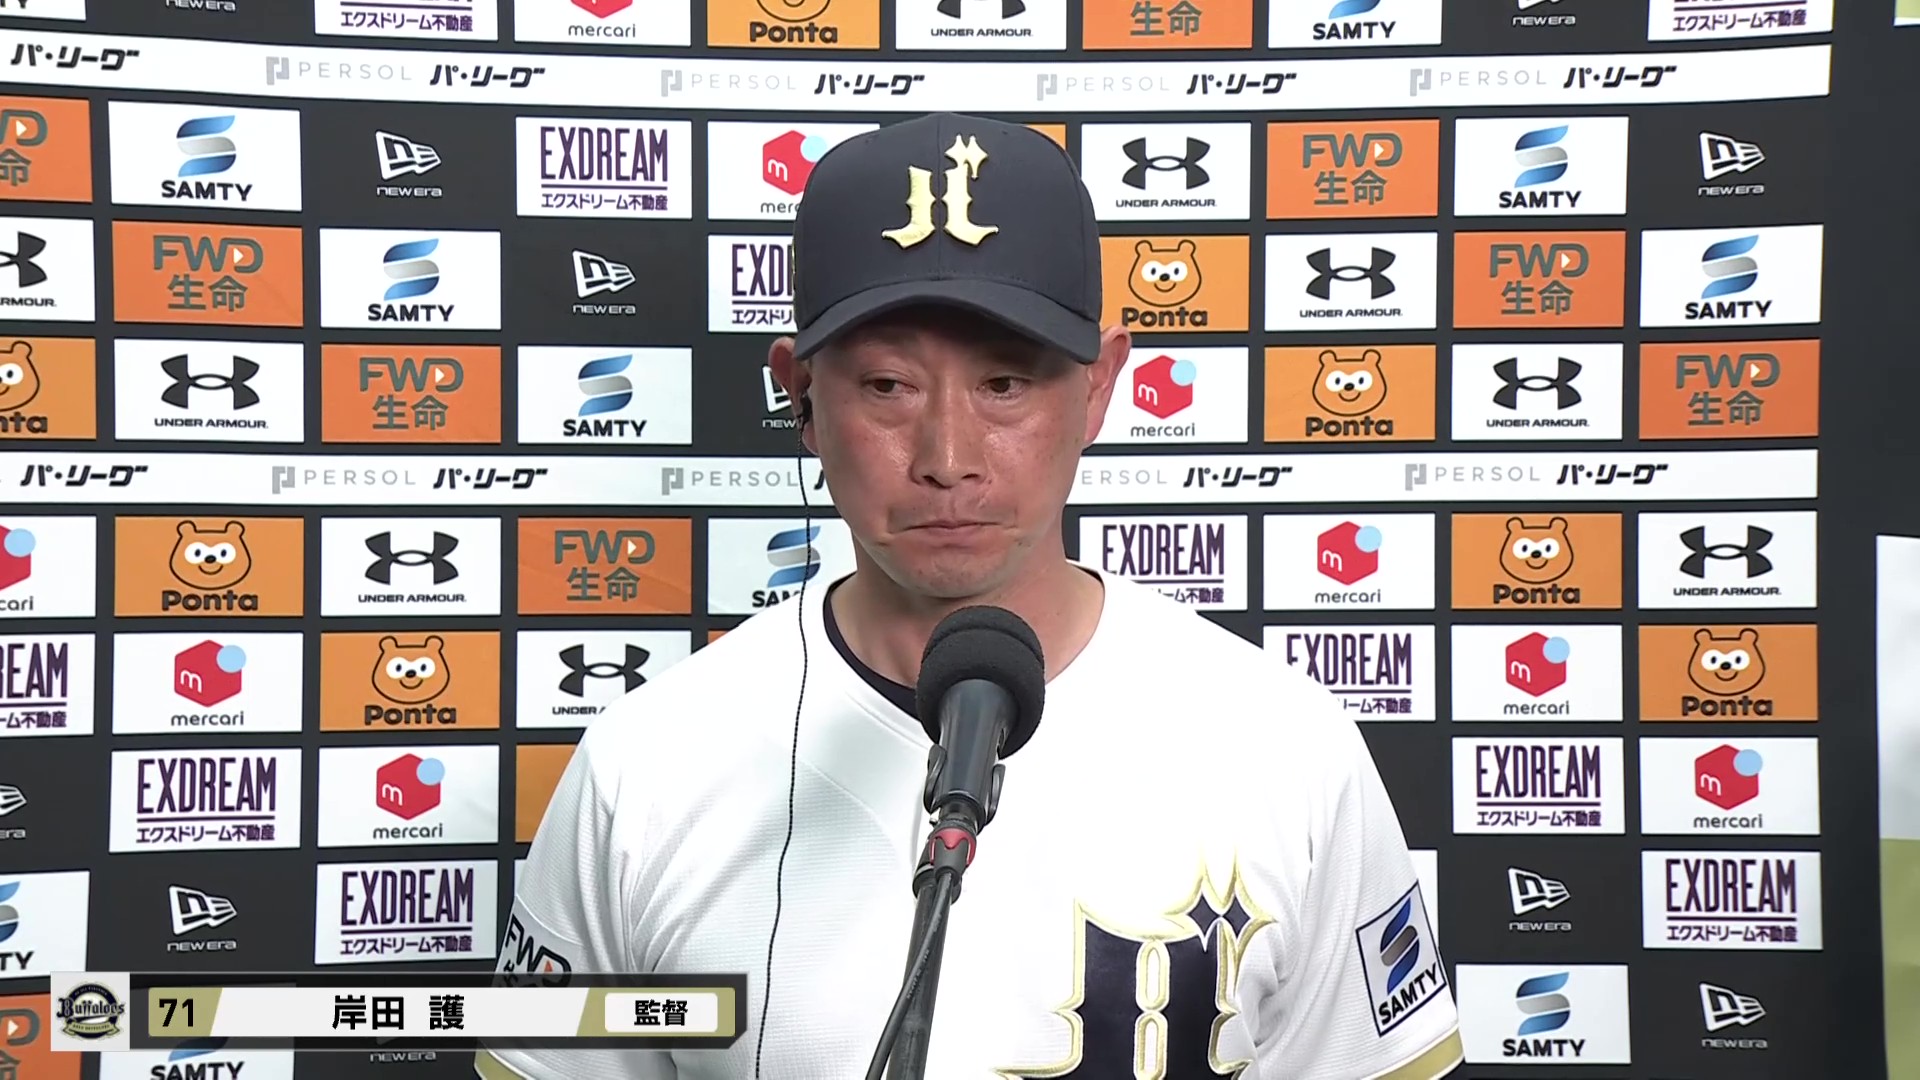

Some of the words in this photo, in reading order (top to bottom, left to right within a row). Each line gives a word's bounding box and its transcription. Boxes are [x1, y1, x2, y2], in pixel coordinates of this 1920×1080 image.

[1131, 1, 1201, 35] 生命
[569, 24, 635, 37] mercari
[750, 22, 838, 43] Ponta
[1313, 21, 1395, 40] SAMTY
[299, 62, 411, 80] PERSOL
[1441, 70, 1546, 86] PERSOL
[692, 74, 795, 90] PERSOL
[1066, 77, 1169, 91] PERSOL
[541, 127, 667, 181] EXDREAM
[1302, 133, 1403, 169] FWD
[161, 180, 253, 202] SAMTY
[1314, 170, 1387, 206] 生命
[1499, 191, 1582, 209] SAMTY
[153, 235, 264, 273] FWD
[1489, 244, 1589, 279] FWD
[167, 274, 248, 312] 生命
[1501, 281, 1574, 315] 生命
[368, 303, 455, 322] SAMTY
[1121, 307, 1208, 328] Ponta
[1685, 301, 1772, 320] SAMTY
[360, 358, 463, 392] FWD
[1677, 354, 1779, 388] FWD
[373, 395, 448, 430] 生命
[1689, 391, 1763, 425] 生命
[564, 419, 646, 437] SAMTY
[1130, 422, 1195, 437] mercari
[1306, 415, 1392, 436] Ponta
[1487, 419, 1530, 427] UNDER
[305, 470, 415, 485] PERSOL
[692, 471, 798, 486] PERSOL
[1436, 466, 1540, 481] PERSOL
[554, 530, 655, 564] FWD
[1102, 523, 1224, 575] EXDREAM
[566, 567, 641, 602] 生命
[1493, 585, 1581, 605] Ponta
[162, 589, 258, 611] Ponta
[1158, 588, 1224, 603] ーム不動産
[1315, 589, 1380, 603] mercari
[1287, 634, 1411, 685] EXDREAM
[0, 643, 68, 698] EAM
[365, 704, 456, 726] Ponta
[552, 706, 597, 715] UNDER
[1504, 701, 1569, 714] mercari
[1682, 695, 1773, 718] Ponta
[171, 710, 243, 727] mercari
[1476, 745, 1601, 798] EXDREAM
[136, 757, 276, 814] EXDREAM
[373, 823, 442, 838] mercari
[1694, 814, 1762, 828] mercari
[1665, 858, 1796, 913] EXDREAM
[341, 868, 474, 926] EXDREAM
[1378, 963, 1439, 1026] SAMTY
[1503, 1038, 1585, 1057] SAMTY
[151, 1062, 243, 1080] SAMTY
